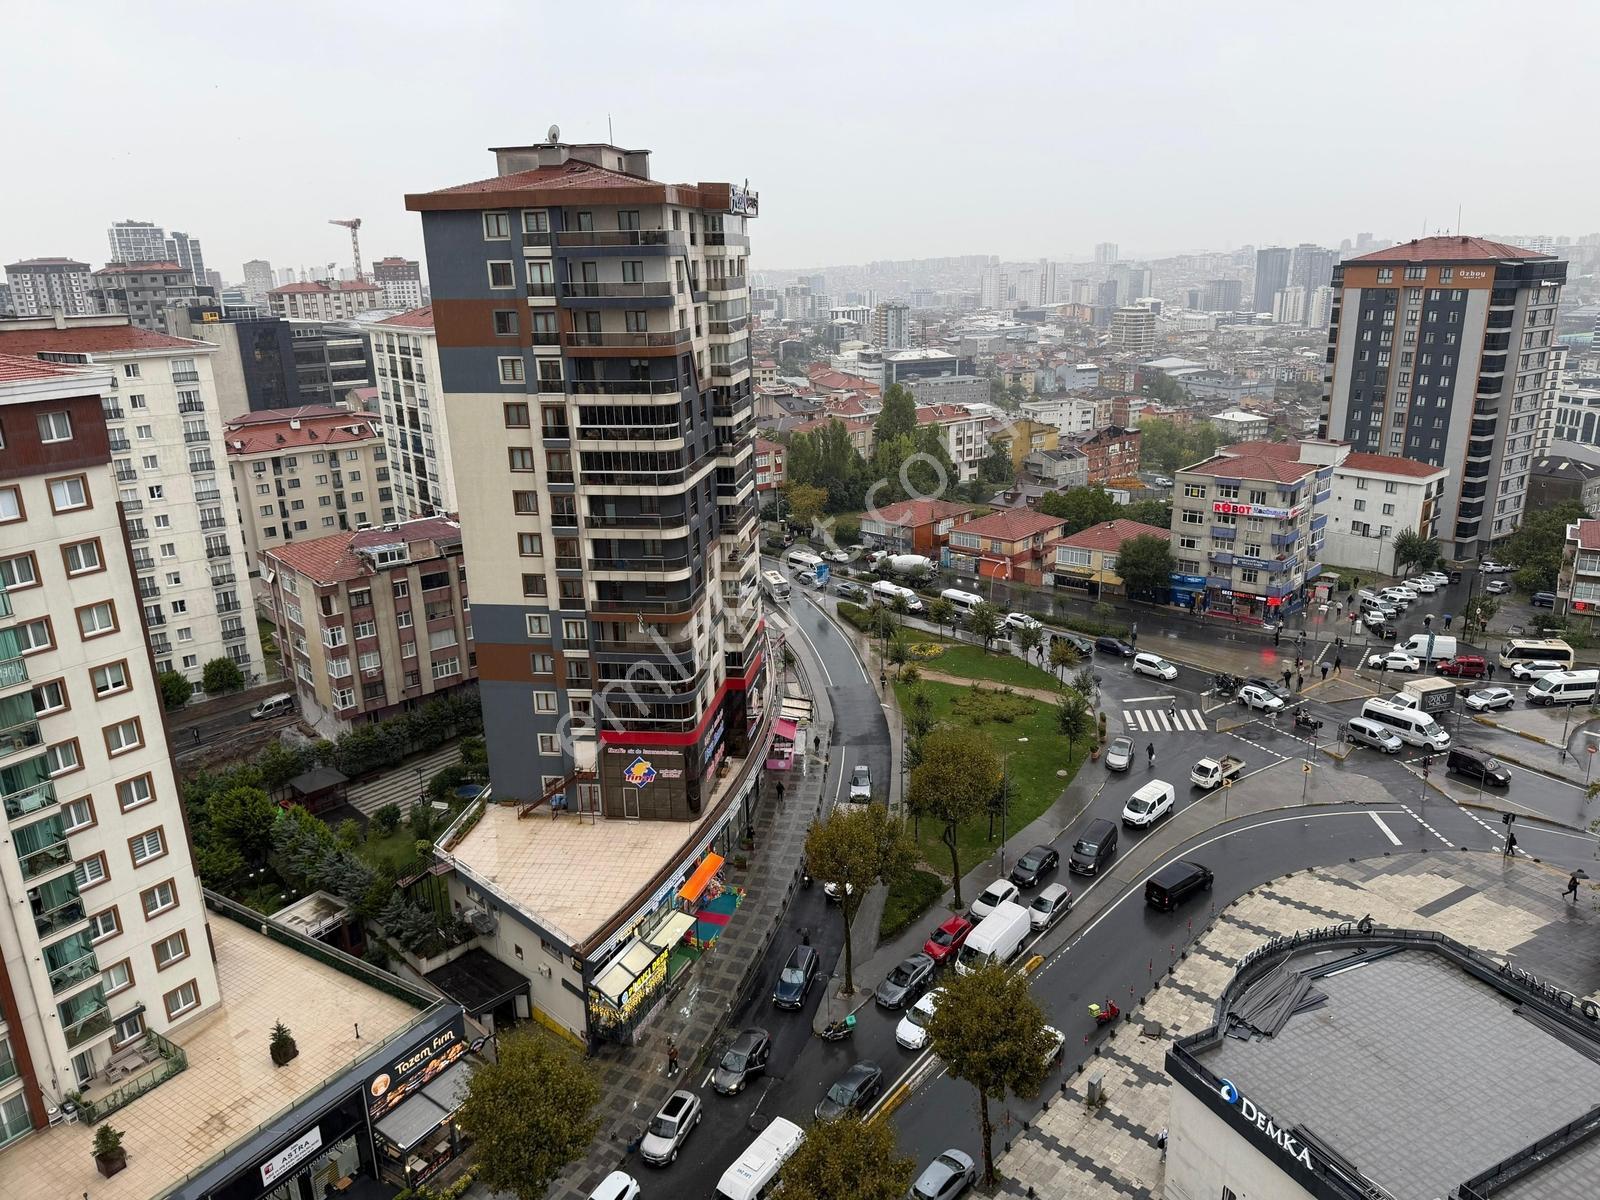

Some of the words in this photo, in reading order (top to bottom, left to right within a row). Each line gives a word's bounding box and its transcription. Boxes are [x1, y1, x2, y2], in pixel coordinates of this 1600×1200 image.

[1214, 502, 1252, 515] ROBOT
[394, 1047, 432, 1075] Tazem
[1241, 1097, 1314, 1171] DEMKA
[281, 1140, 310, 1164] ASTRA
